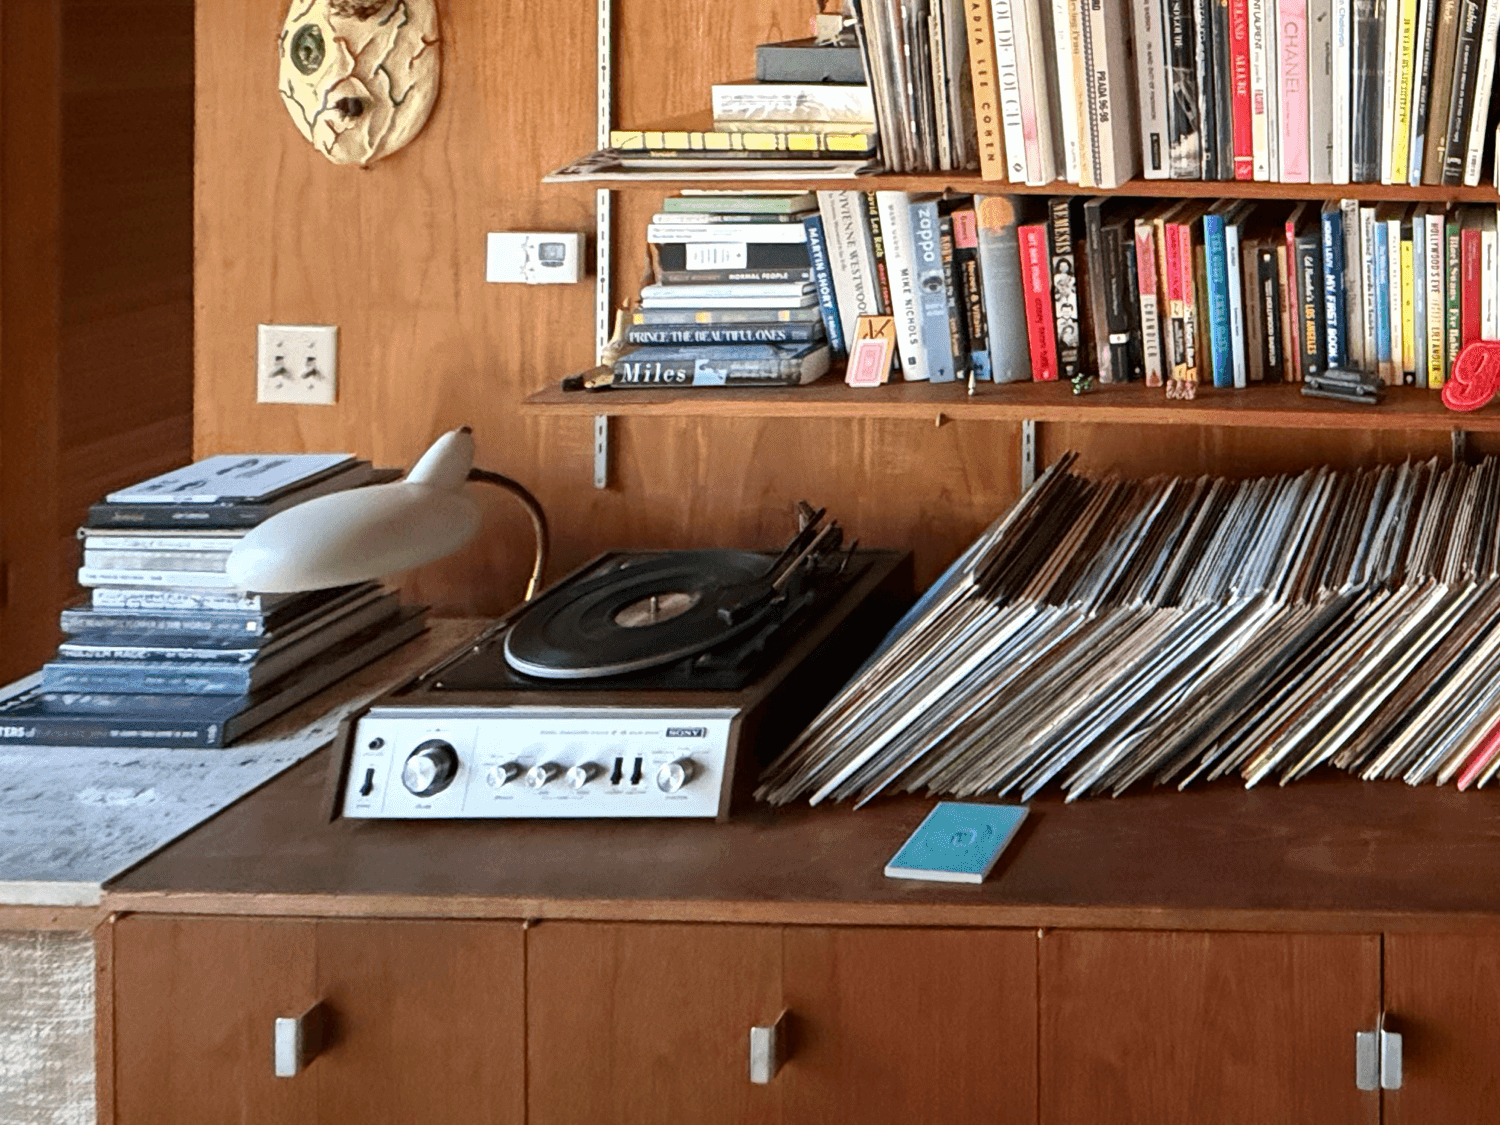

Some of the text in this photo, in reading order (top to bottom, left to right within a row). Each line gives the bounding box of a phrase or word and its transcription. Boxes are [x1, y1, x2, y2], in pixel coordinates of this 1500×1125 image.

[977, 59, 990, 88] LEE
[1096, 70, 1108, 99] PRADA
[1284, 21, 1300, 97] CHANEL
[982, 102, 996, 162] COHEN
[871, 218, 884, 258] Lee Roth
[1053, 203, 1071, 255] NEMESIS
[1449, 235, 1459, 266] Black
[762, 272, 788, 280] PEOPLE
[808, 227, 834, 309] MARTIN SHORT
[1430, 222, 1441, 294] HOLLYWOOD'S EVE
[900, 268, 918, 345] MIKE NICHOLS
[966, 260, 983, 338] Heroes Villains
[1325, 274, 1338, 359] MY FIRST BOOK
[629, 331, 667, 342] PRINCE
[756, 329, 786, 341] ONES
[1144, 303, 1157, 358] CHANDLER
[1306, 304, 1317, 355] LOS ANGELES
[621, 361, 687, 383] Miles
